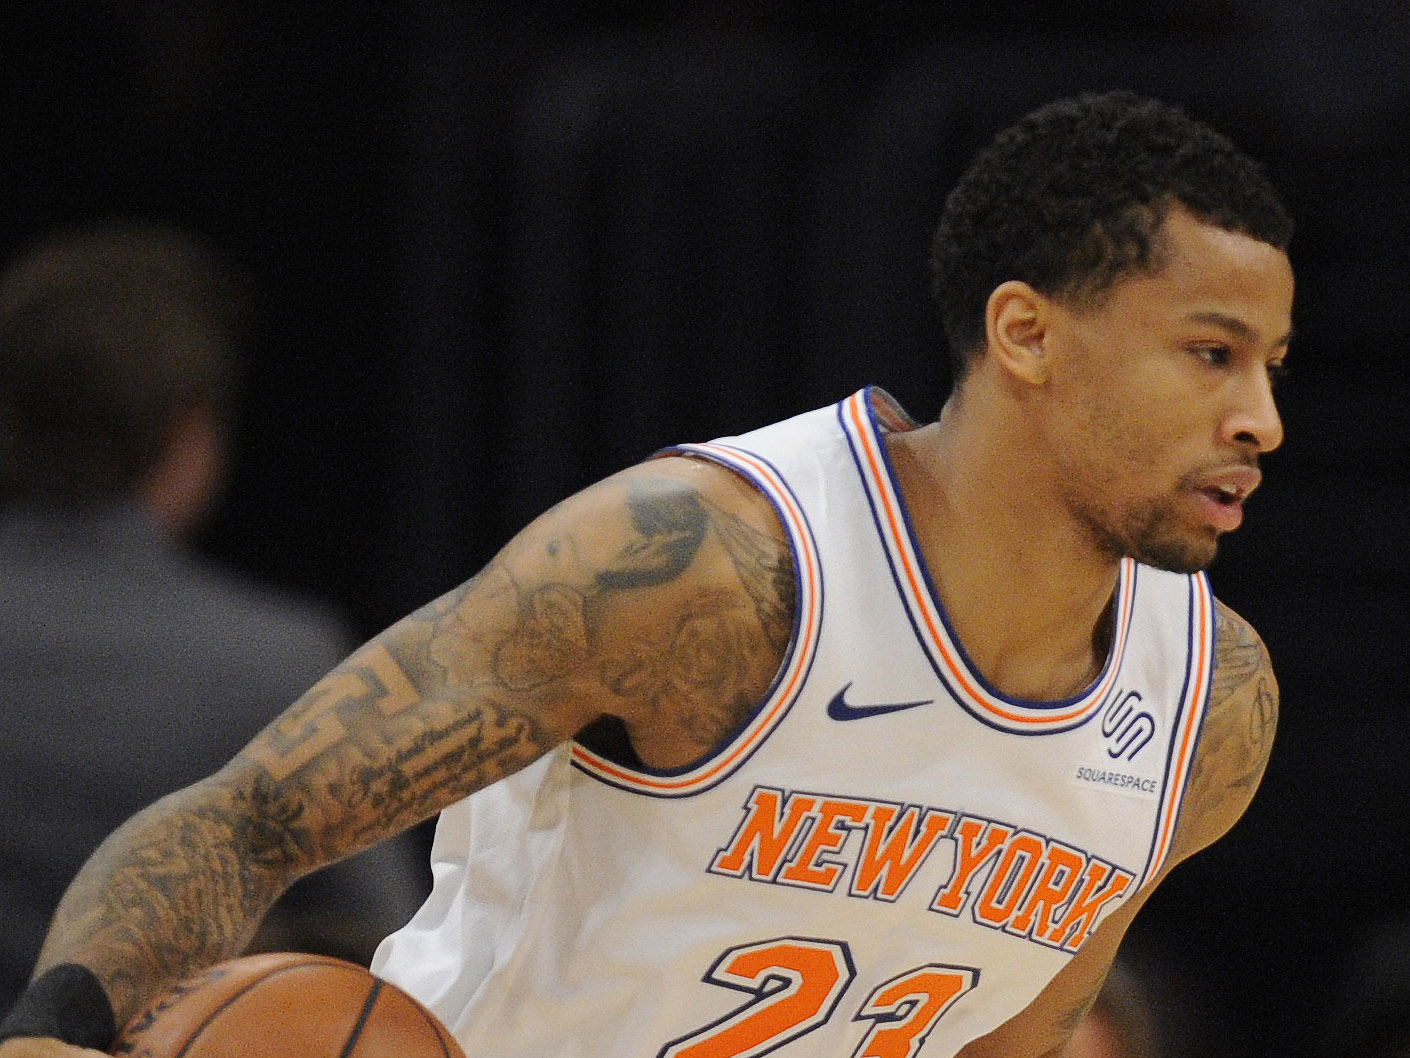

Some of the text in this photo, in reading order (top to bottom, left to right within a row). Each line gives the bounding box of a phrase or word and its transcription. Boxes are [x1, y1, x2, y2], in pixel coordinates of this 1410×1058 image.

[1076, 766, 1158, 794] SQUARESPACE
[706, 785, 1137, 955] NEW YORK
